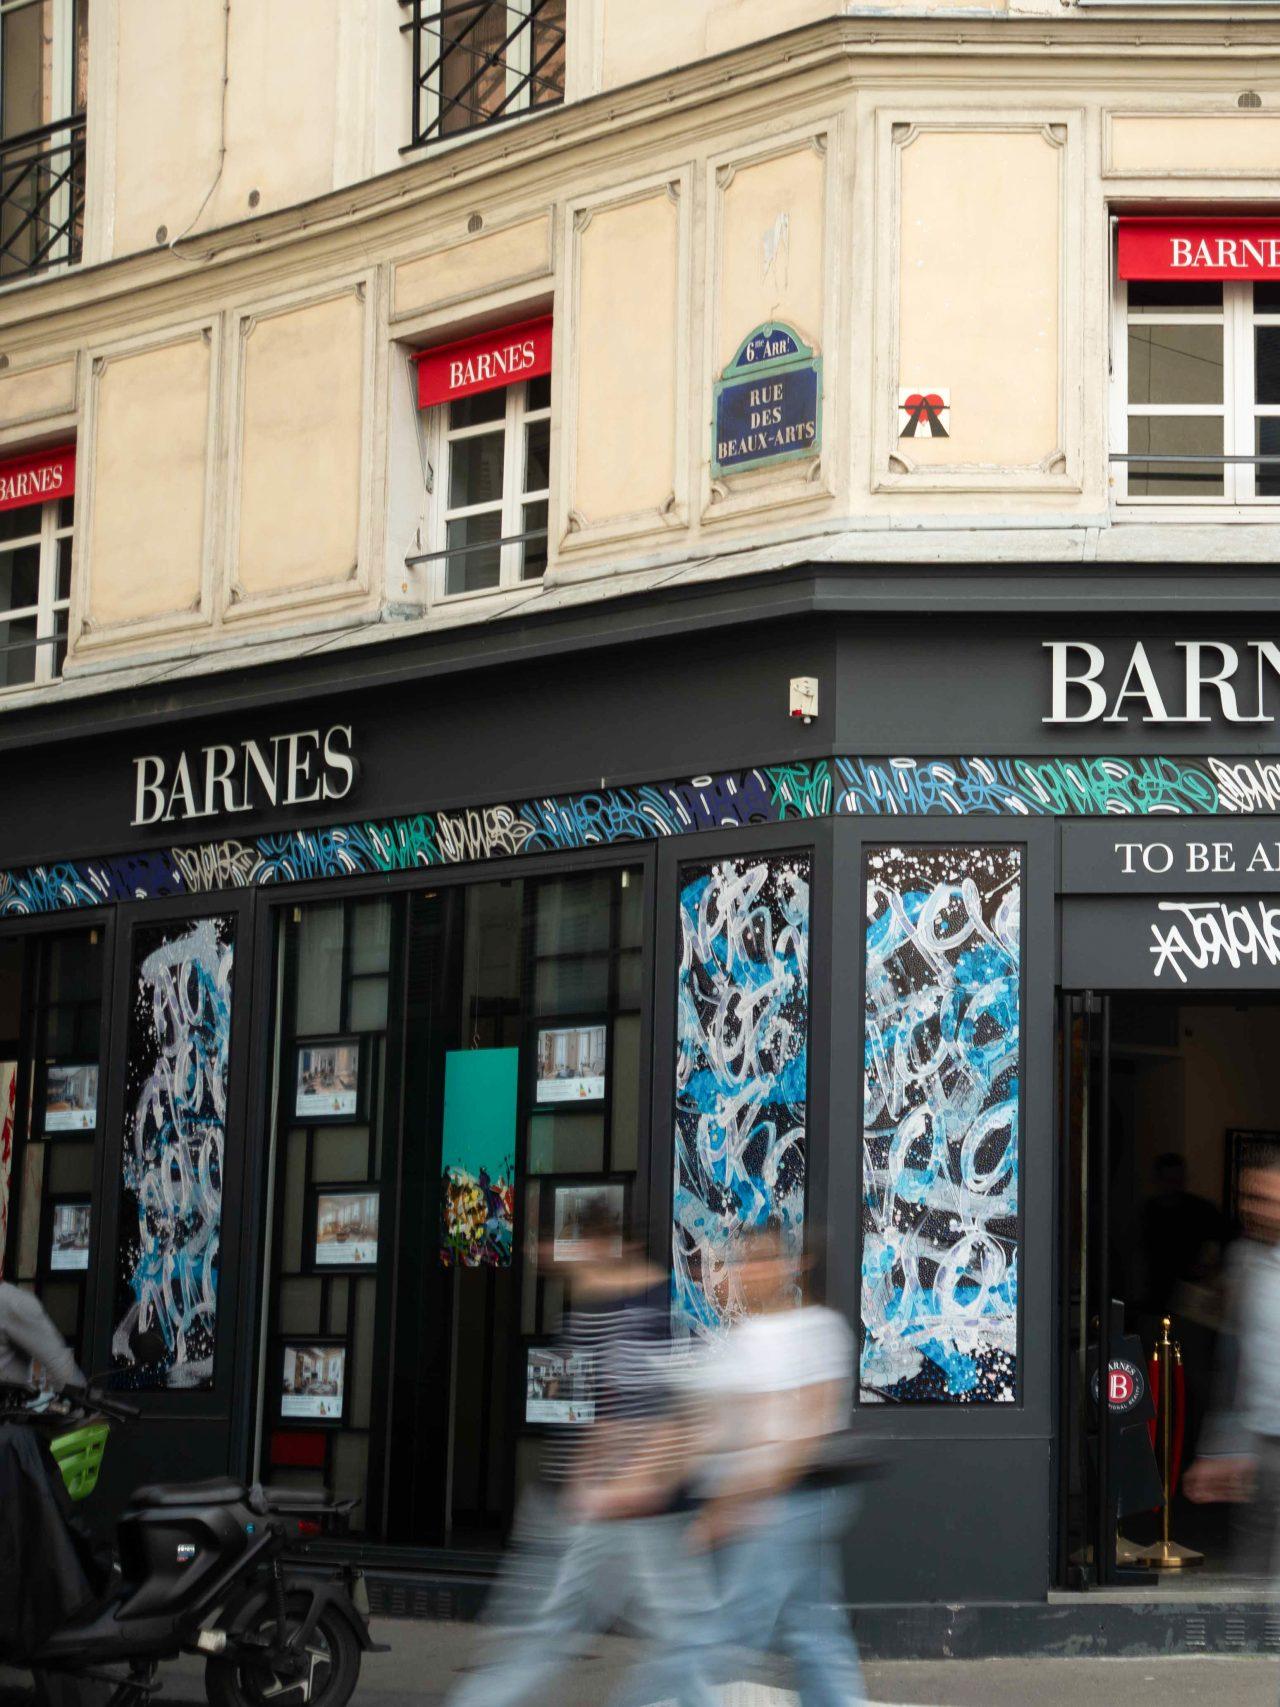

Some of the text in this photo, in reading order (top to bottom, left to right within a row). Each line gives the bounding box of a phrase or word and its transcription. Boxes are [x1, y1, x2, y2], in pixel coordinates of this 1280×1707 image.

[449, 340, 535, 389] BARNES
[750, 383, 783, 407] RUE
[751, 406, 782, 429] DES
[718, 421, 815, 459] BEAUX-ARTS
[130, 725, 354, 826] BARNES
[1114, 842, 1174, 873] TO
[1185, 842, 1236, 873] BE
[1108, 1361, 1136, 1376] ARNES
